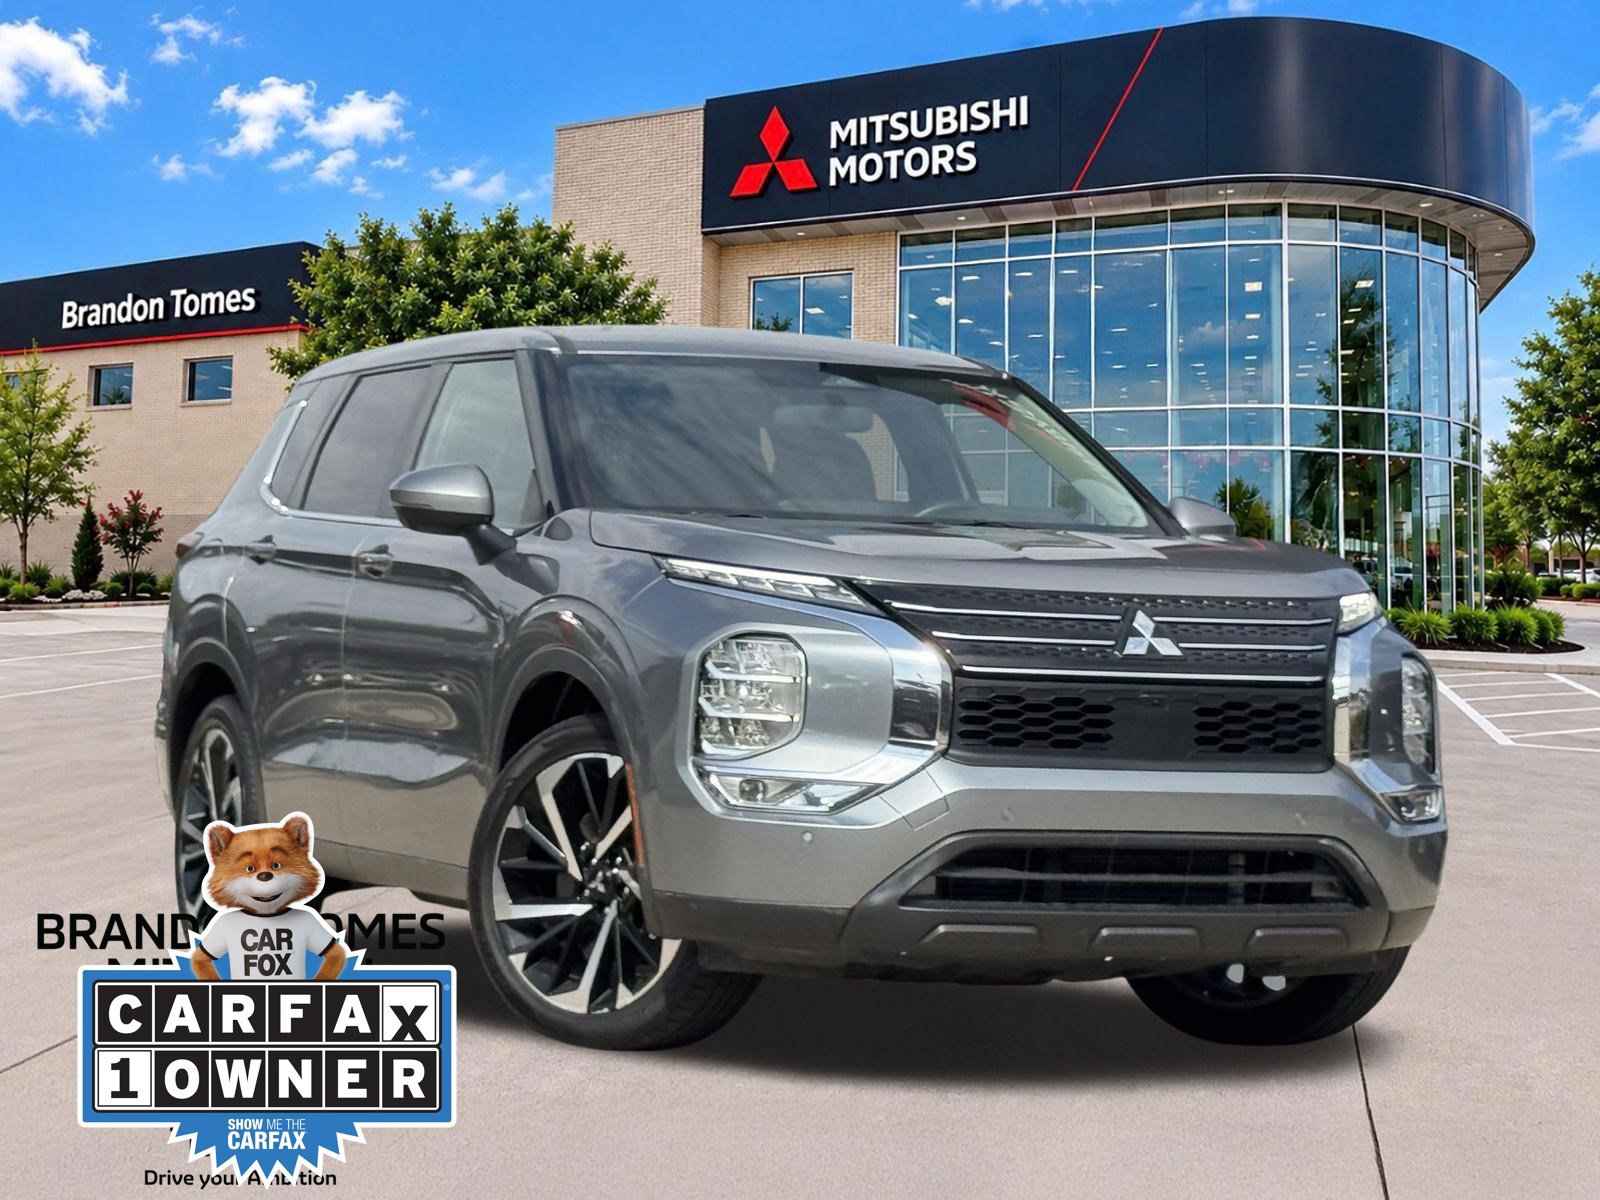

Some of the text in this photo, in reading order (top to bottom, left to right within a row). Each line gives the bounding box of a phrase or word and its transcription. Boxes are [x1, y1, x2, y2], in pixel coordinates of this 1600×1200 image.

[830, 95, 1029, 149] MITSUBISHI
[829, 141, 978, 187] MOTORS
[61, 287, 256, 329] Brandon Tomes
